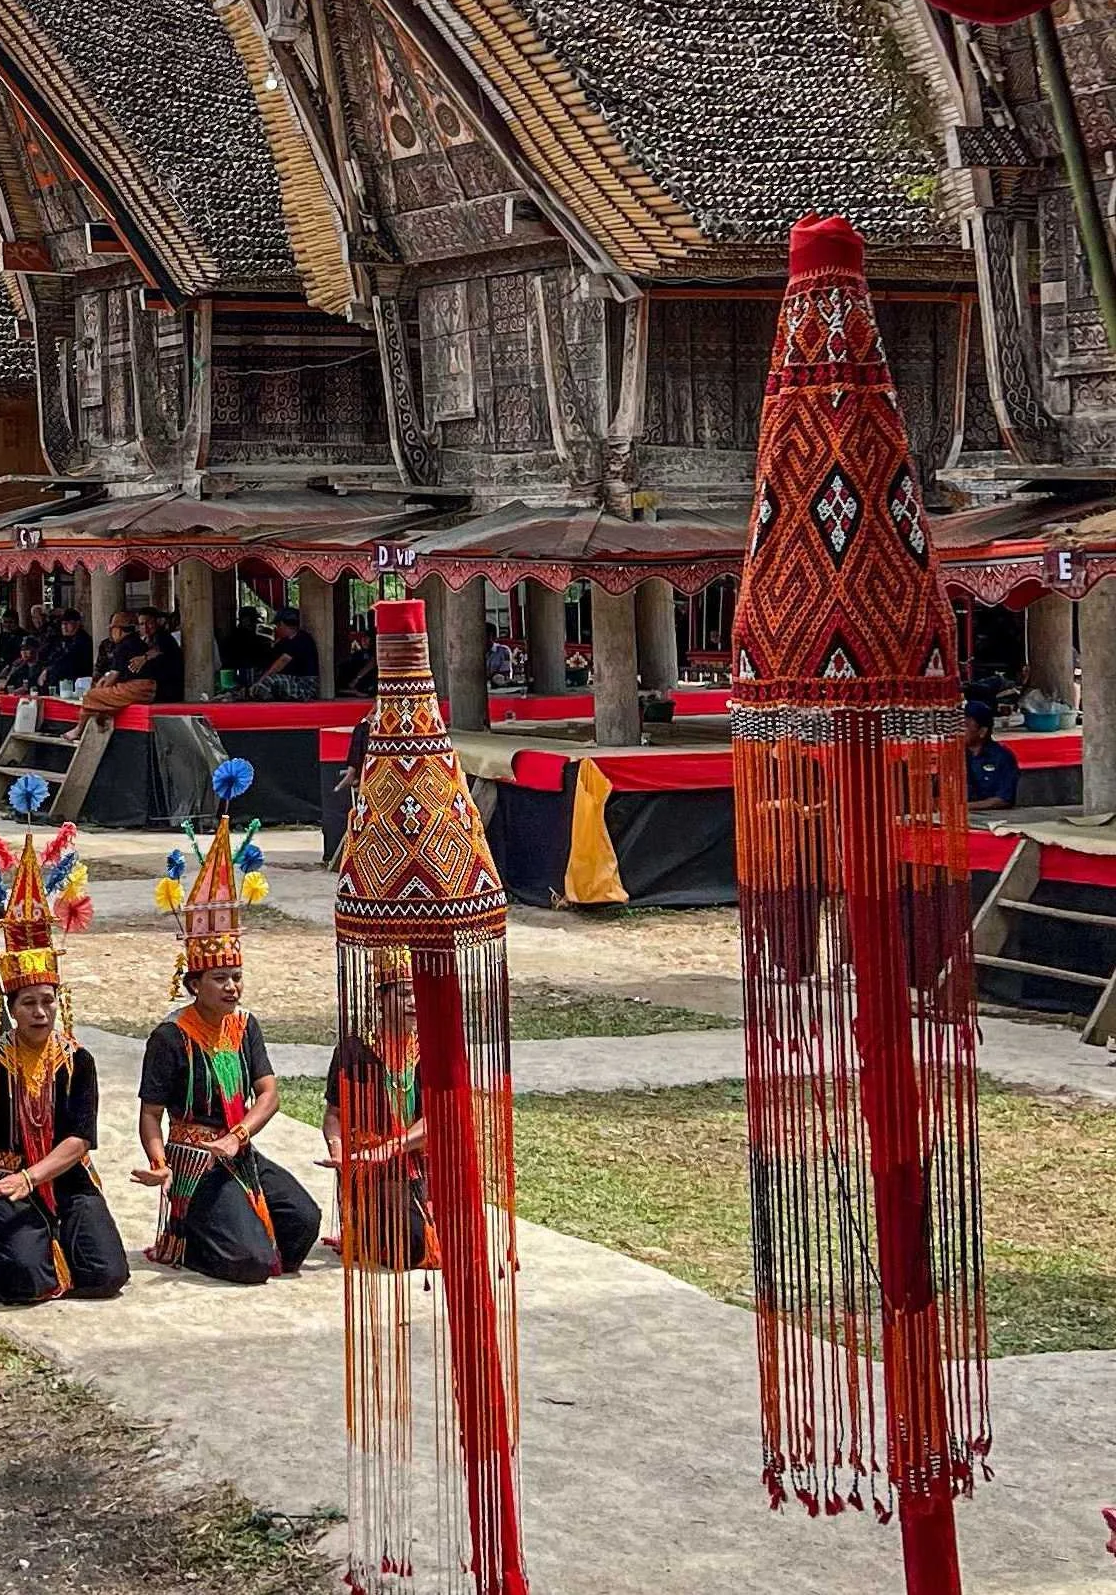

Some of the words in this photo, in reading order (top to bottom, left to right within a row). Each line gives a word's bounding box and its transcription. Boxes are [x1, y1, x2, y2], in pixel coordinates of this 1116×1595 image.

[378, 545, 388, 565] D
[396, 548, 416, 565] VIP
[1059, 552, 1072, 580] E
